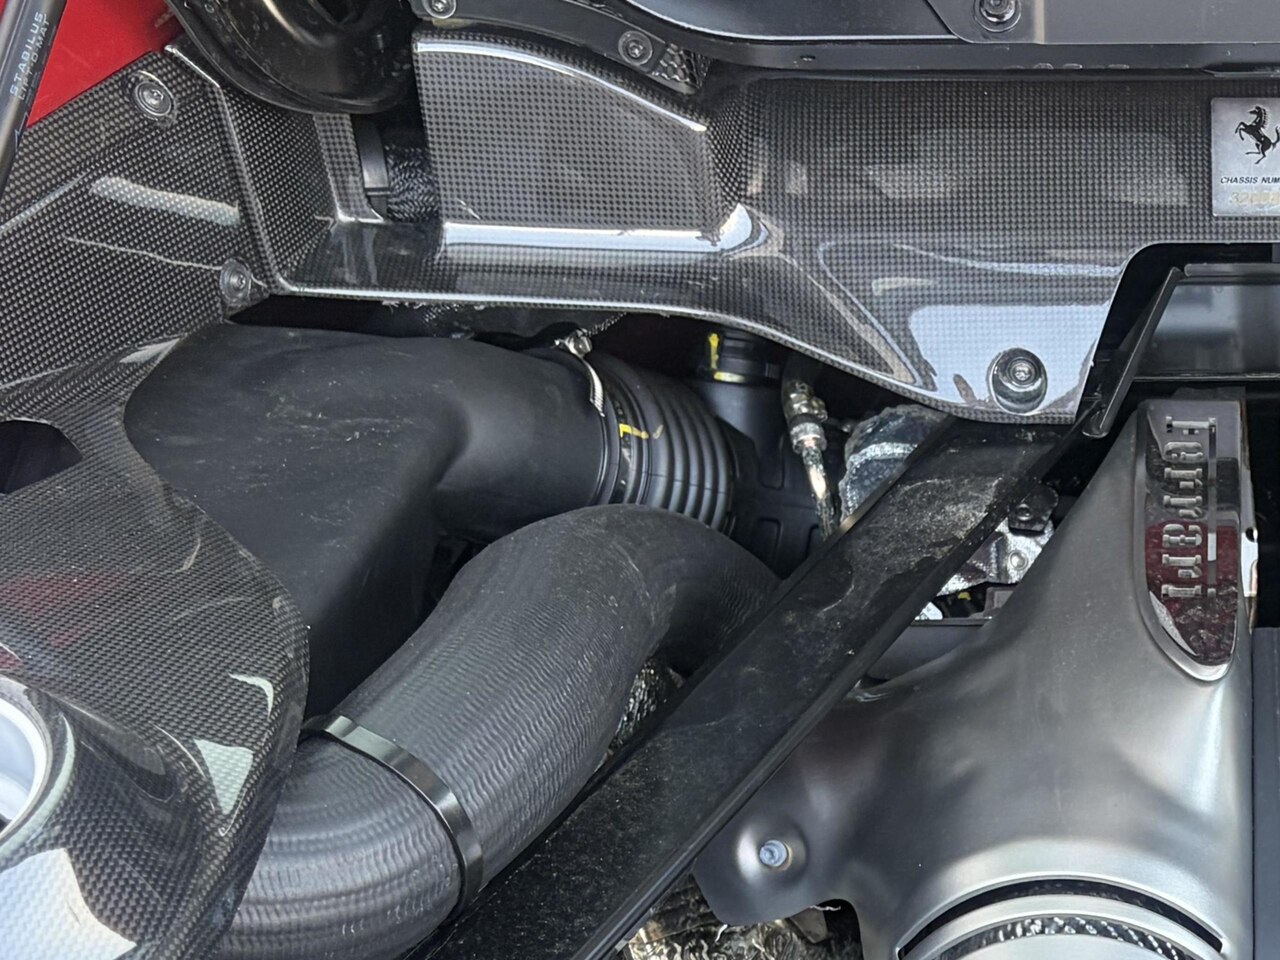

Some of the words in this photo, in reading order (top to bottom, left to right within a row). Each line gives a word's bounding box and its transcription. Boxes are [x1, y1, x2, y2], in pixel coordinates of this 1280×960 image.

[10, 11, 44, 97] STABILUS
[1220, 176, 1258, 184] CHASSIS
[1161, 414, 1217, 598] Ferrari
